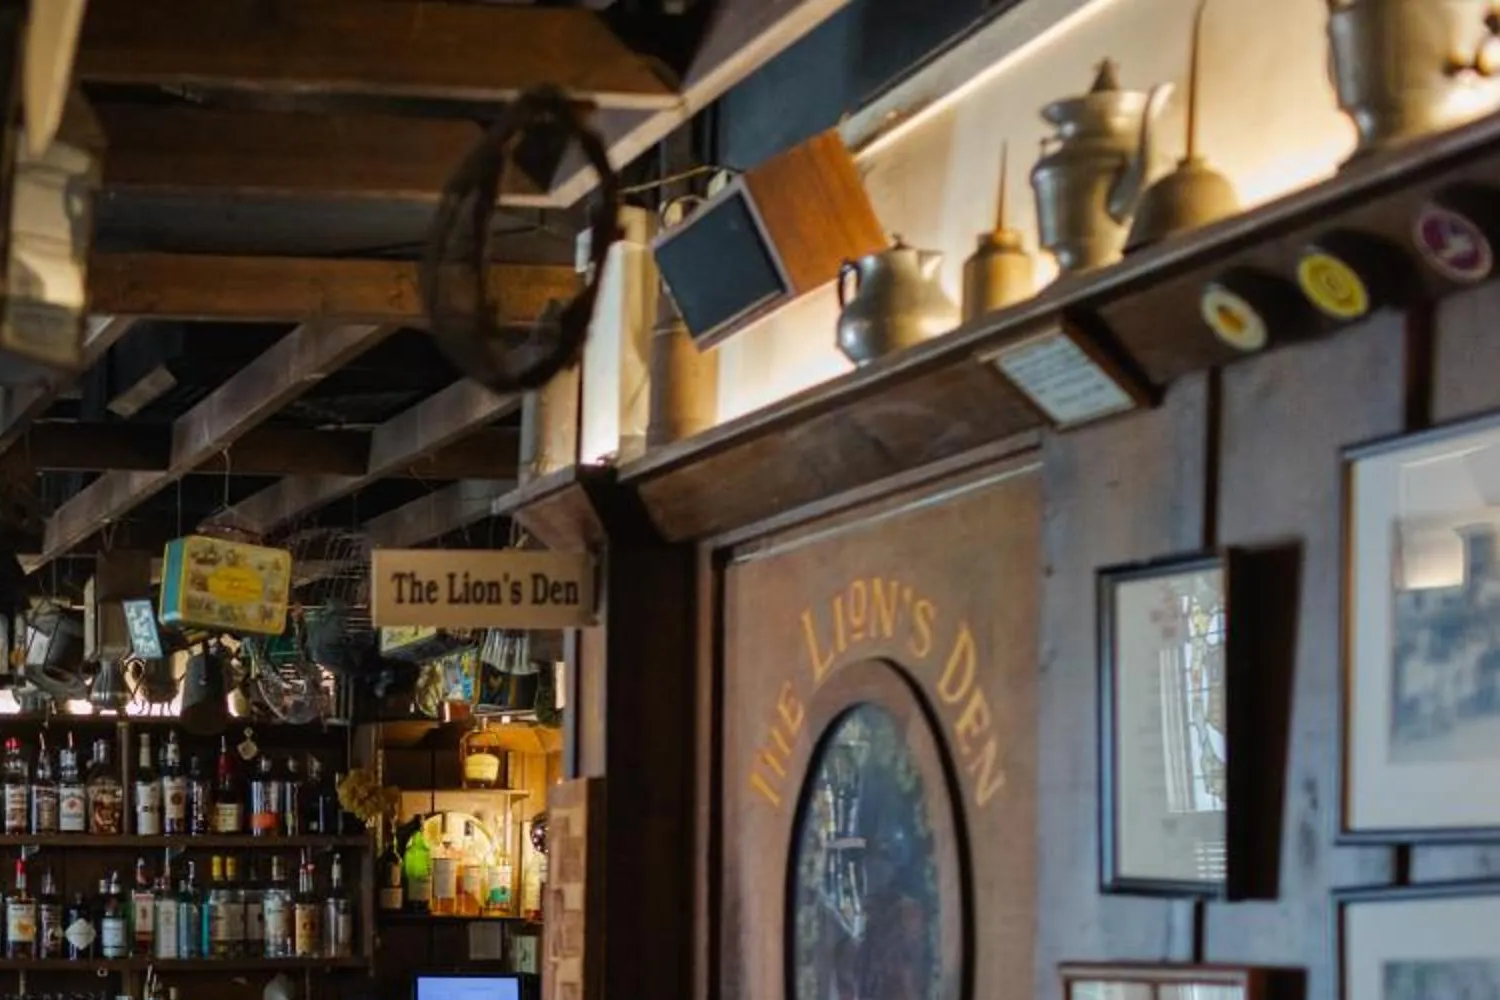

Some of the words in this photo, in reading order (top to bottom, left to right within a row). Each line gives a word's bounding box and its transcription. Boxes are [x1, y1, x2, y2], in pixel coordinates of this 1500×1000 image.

[391, 571, 438, 605] The
[446, 571, 522, 605] Lion's
[530, 573, 579, 605] Den
[749, 680, 805, 808] THE
[801, 577, 936, 684] LION'S
[937, 620, 1005, 808] DEN
